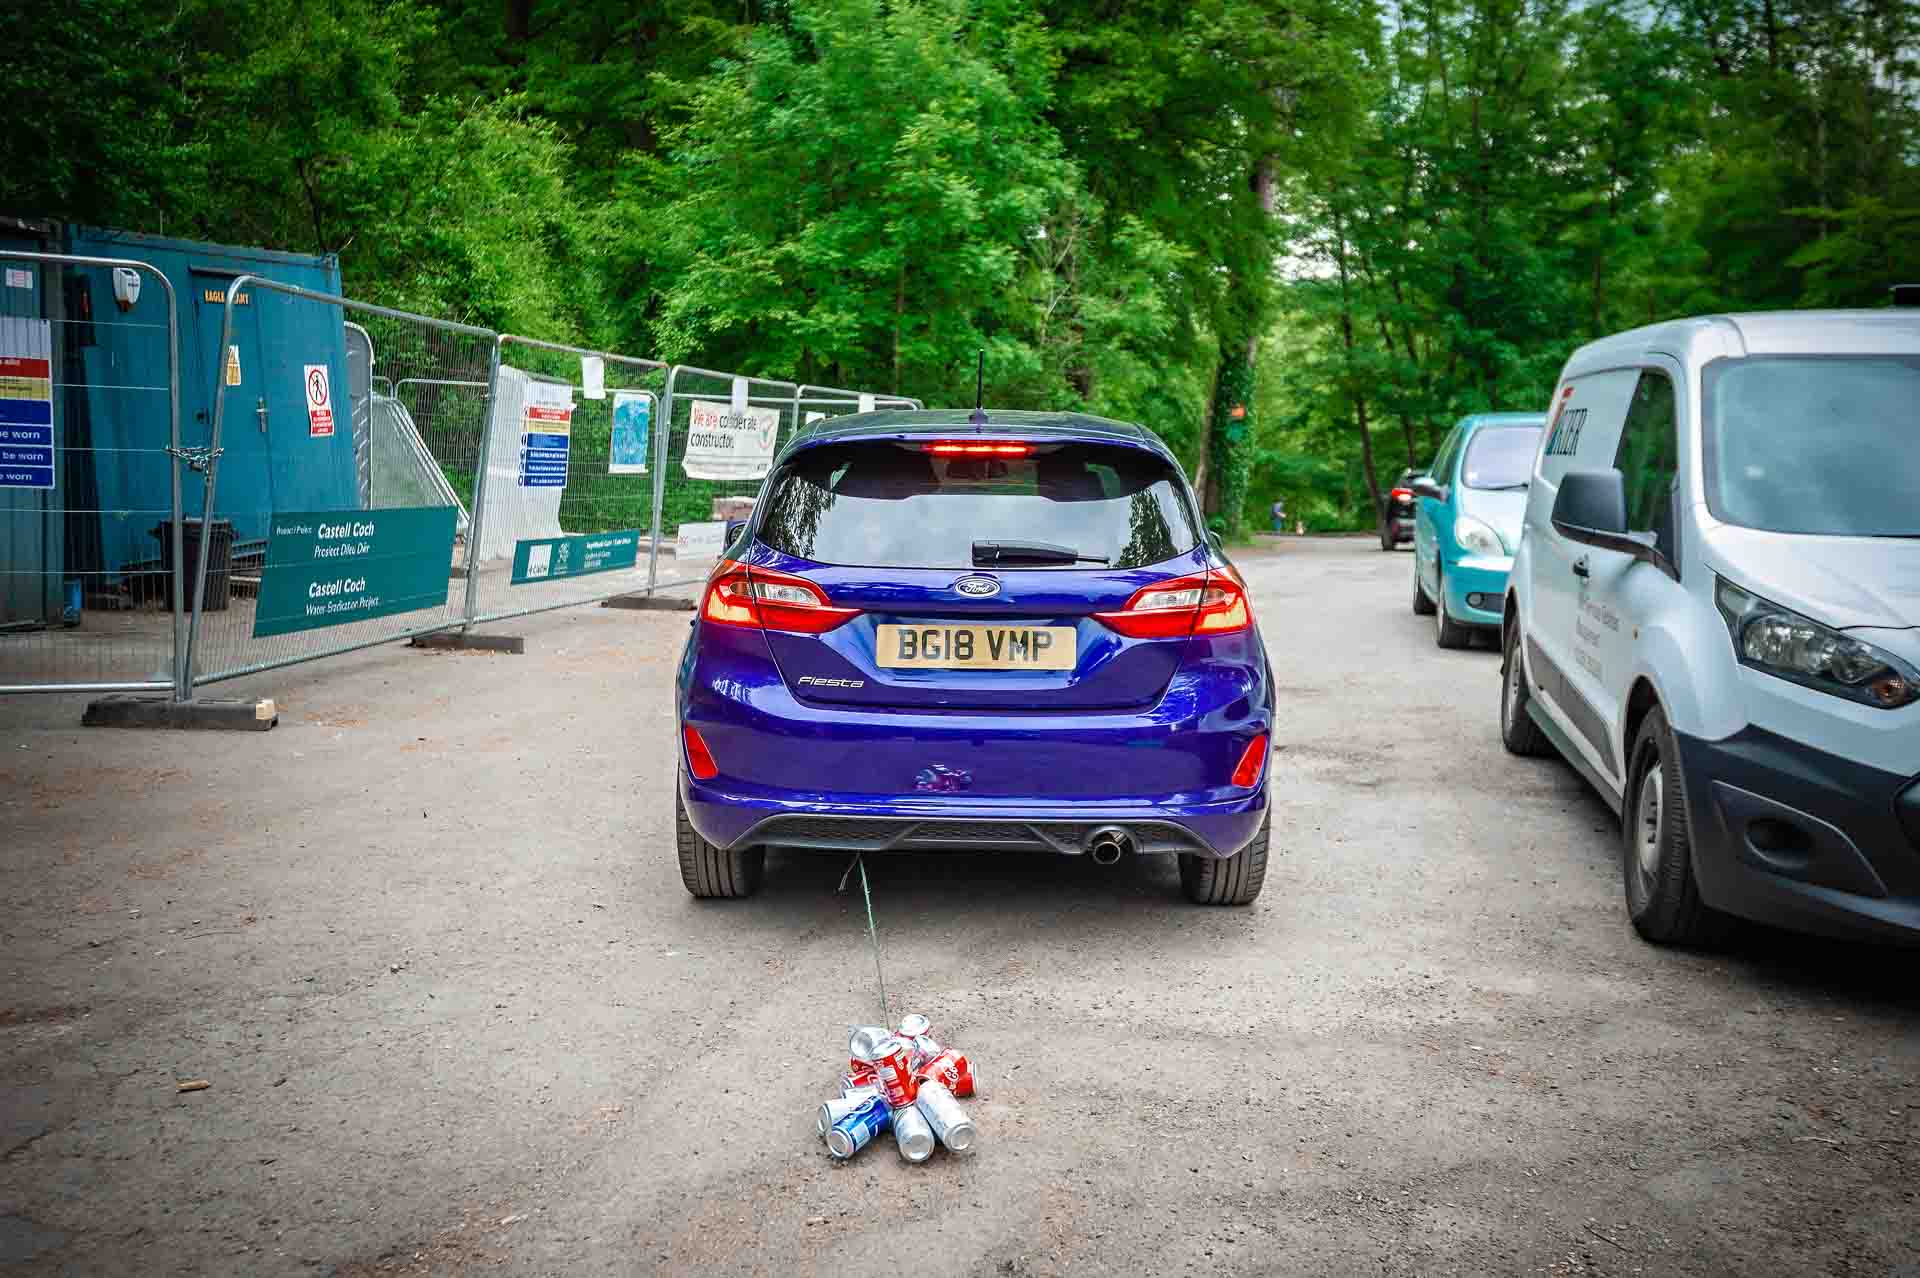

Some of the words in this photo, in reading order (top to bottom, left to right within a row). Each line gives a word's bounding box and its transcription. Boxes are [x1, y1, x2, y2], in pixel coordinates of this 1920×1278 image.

[11, 431, 41, 439] worn
[18, 453, 44, 461] worn
[6, 473, 33, 481] worn
[318, 521, 351, 540] Castell
[352, 520, 375, 537] Coch
[308, 579, 342, 599] Castell
[343, 576, 366, 593] Coch
[897, 628, 974, 661] BG18
[986, 629, 1052, 662] VMP
[798, 676, 865, 689] Fiesta
